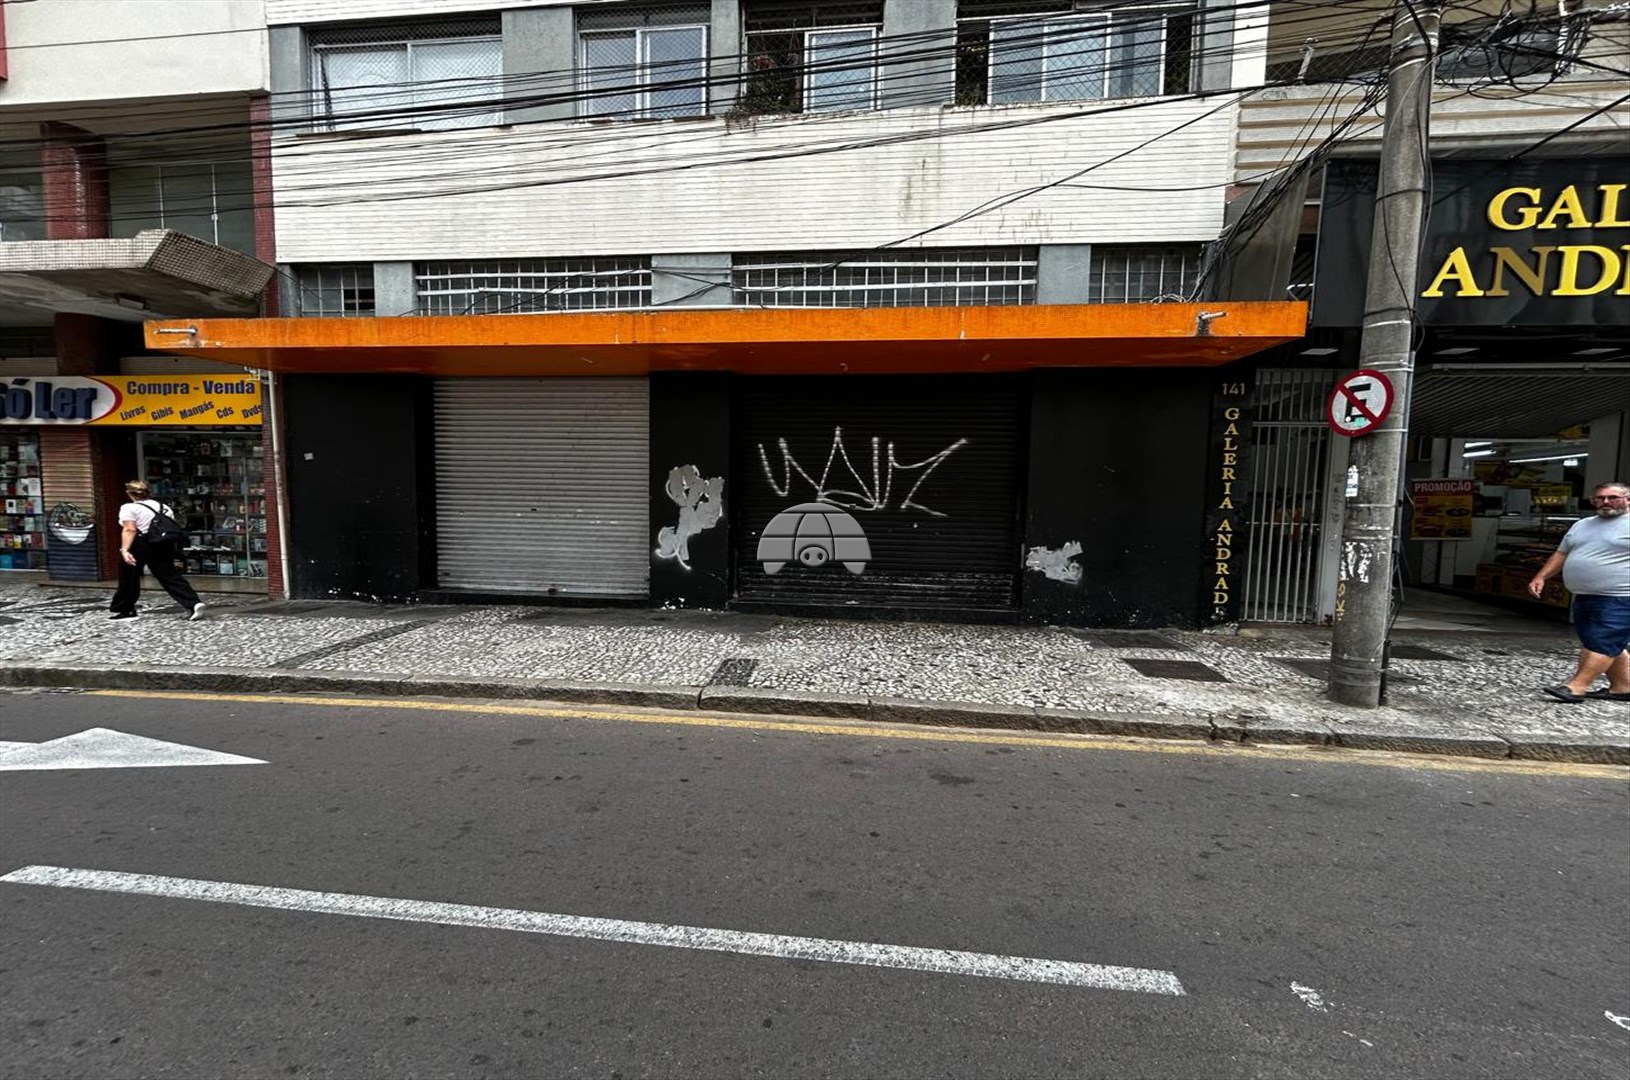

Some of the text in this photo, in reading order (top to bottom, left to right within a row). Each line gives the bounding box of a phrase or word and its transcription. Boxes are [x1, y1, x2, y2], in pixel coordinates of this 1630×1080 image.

[1487, 184, 1630, 231] GAL
[126, 381, 190, 396] Compra
[203, 380, 255, 395] Venda
[1222, 383, 1245, 395] 141
[35, 381, 98, 420] Ler
[120, 405, 146, 421] Livros
[216, 406, 234, 419] Cds
[242, 404, 261, 419] Dvds
[1219, 407, 1240, 509] GALERIA
[1414, 480, 1472, 493] PROMOÇÃO
